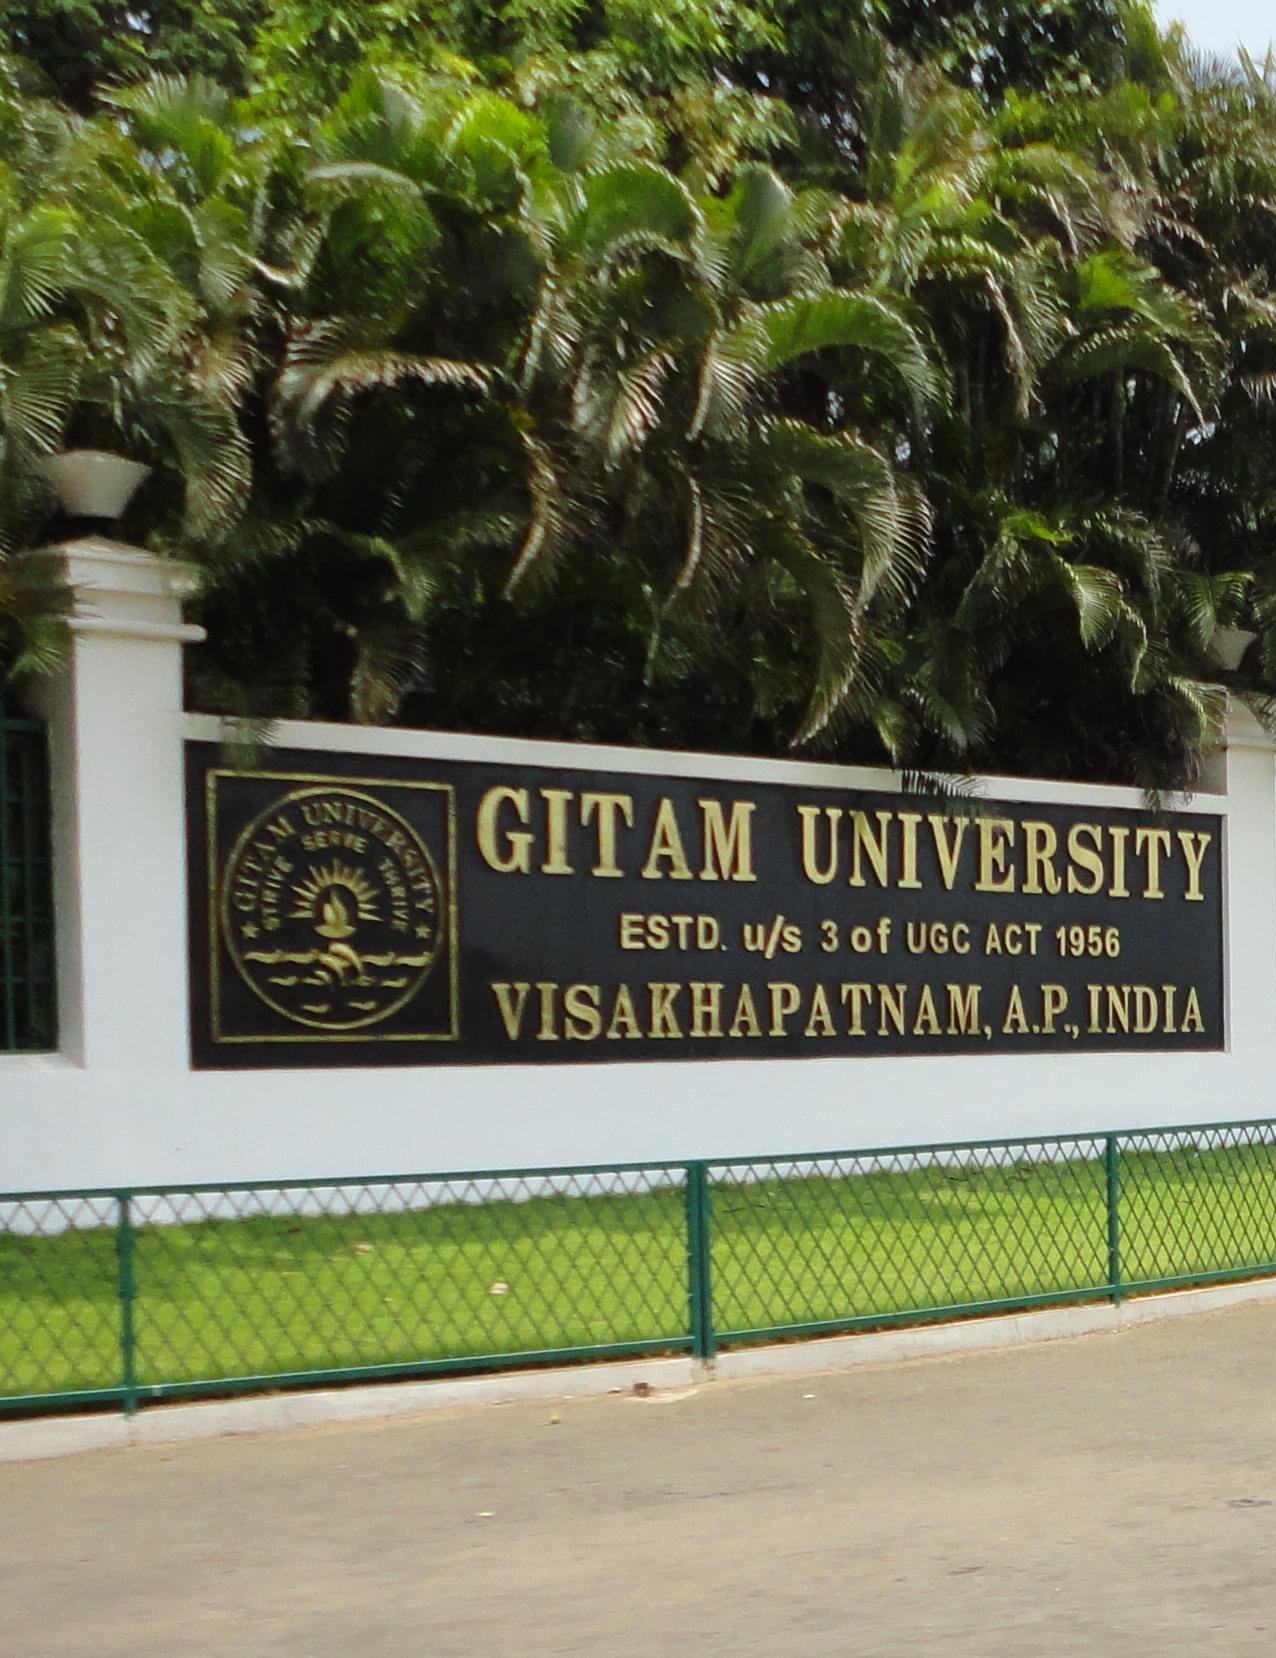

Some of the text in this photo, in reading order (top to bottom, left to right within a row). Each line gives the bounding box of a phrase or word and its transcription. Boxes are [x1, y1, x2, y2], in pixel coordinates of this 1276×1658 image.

[302, 830, 370, 855] SERVE
[476, 785, 1212, 900] GITAM UNIVERSITY
[620, 912, 1121, 960] ESTD. u/s 3 of UGC ACT 1956
[1088, 983, 1206, 1034] INDIA
